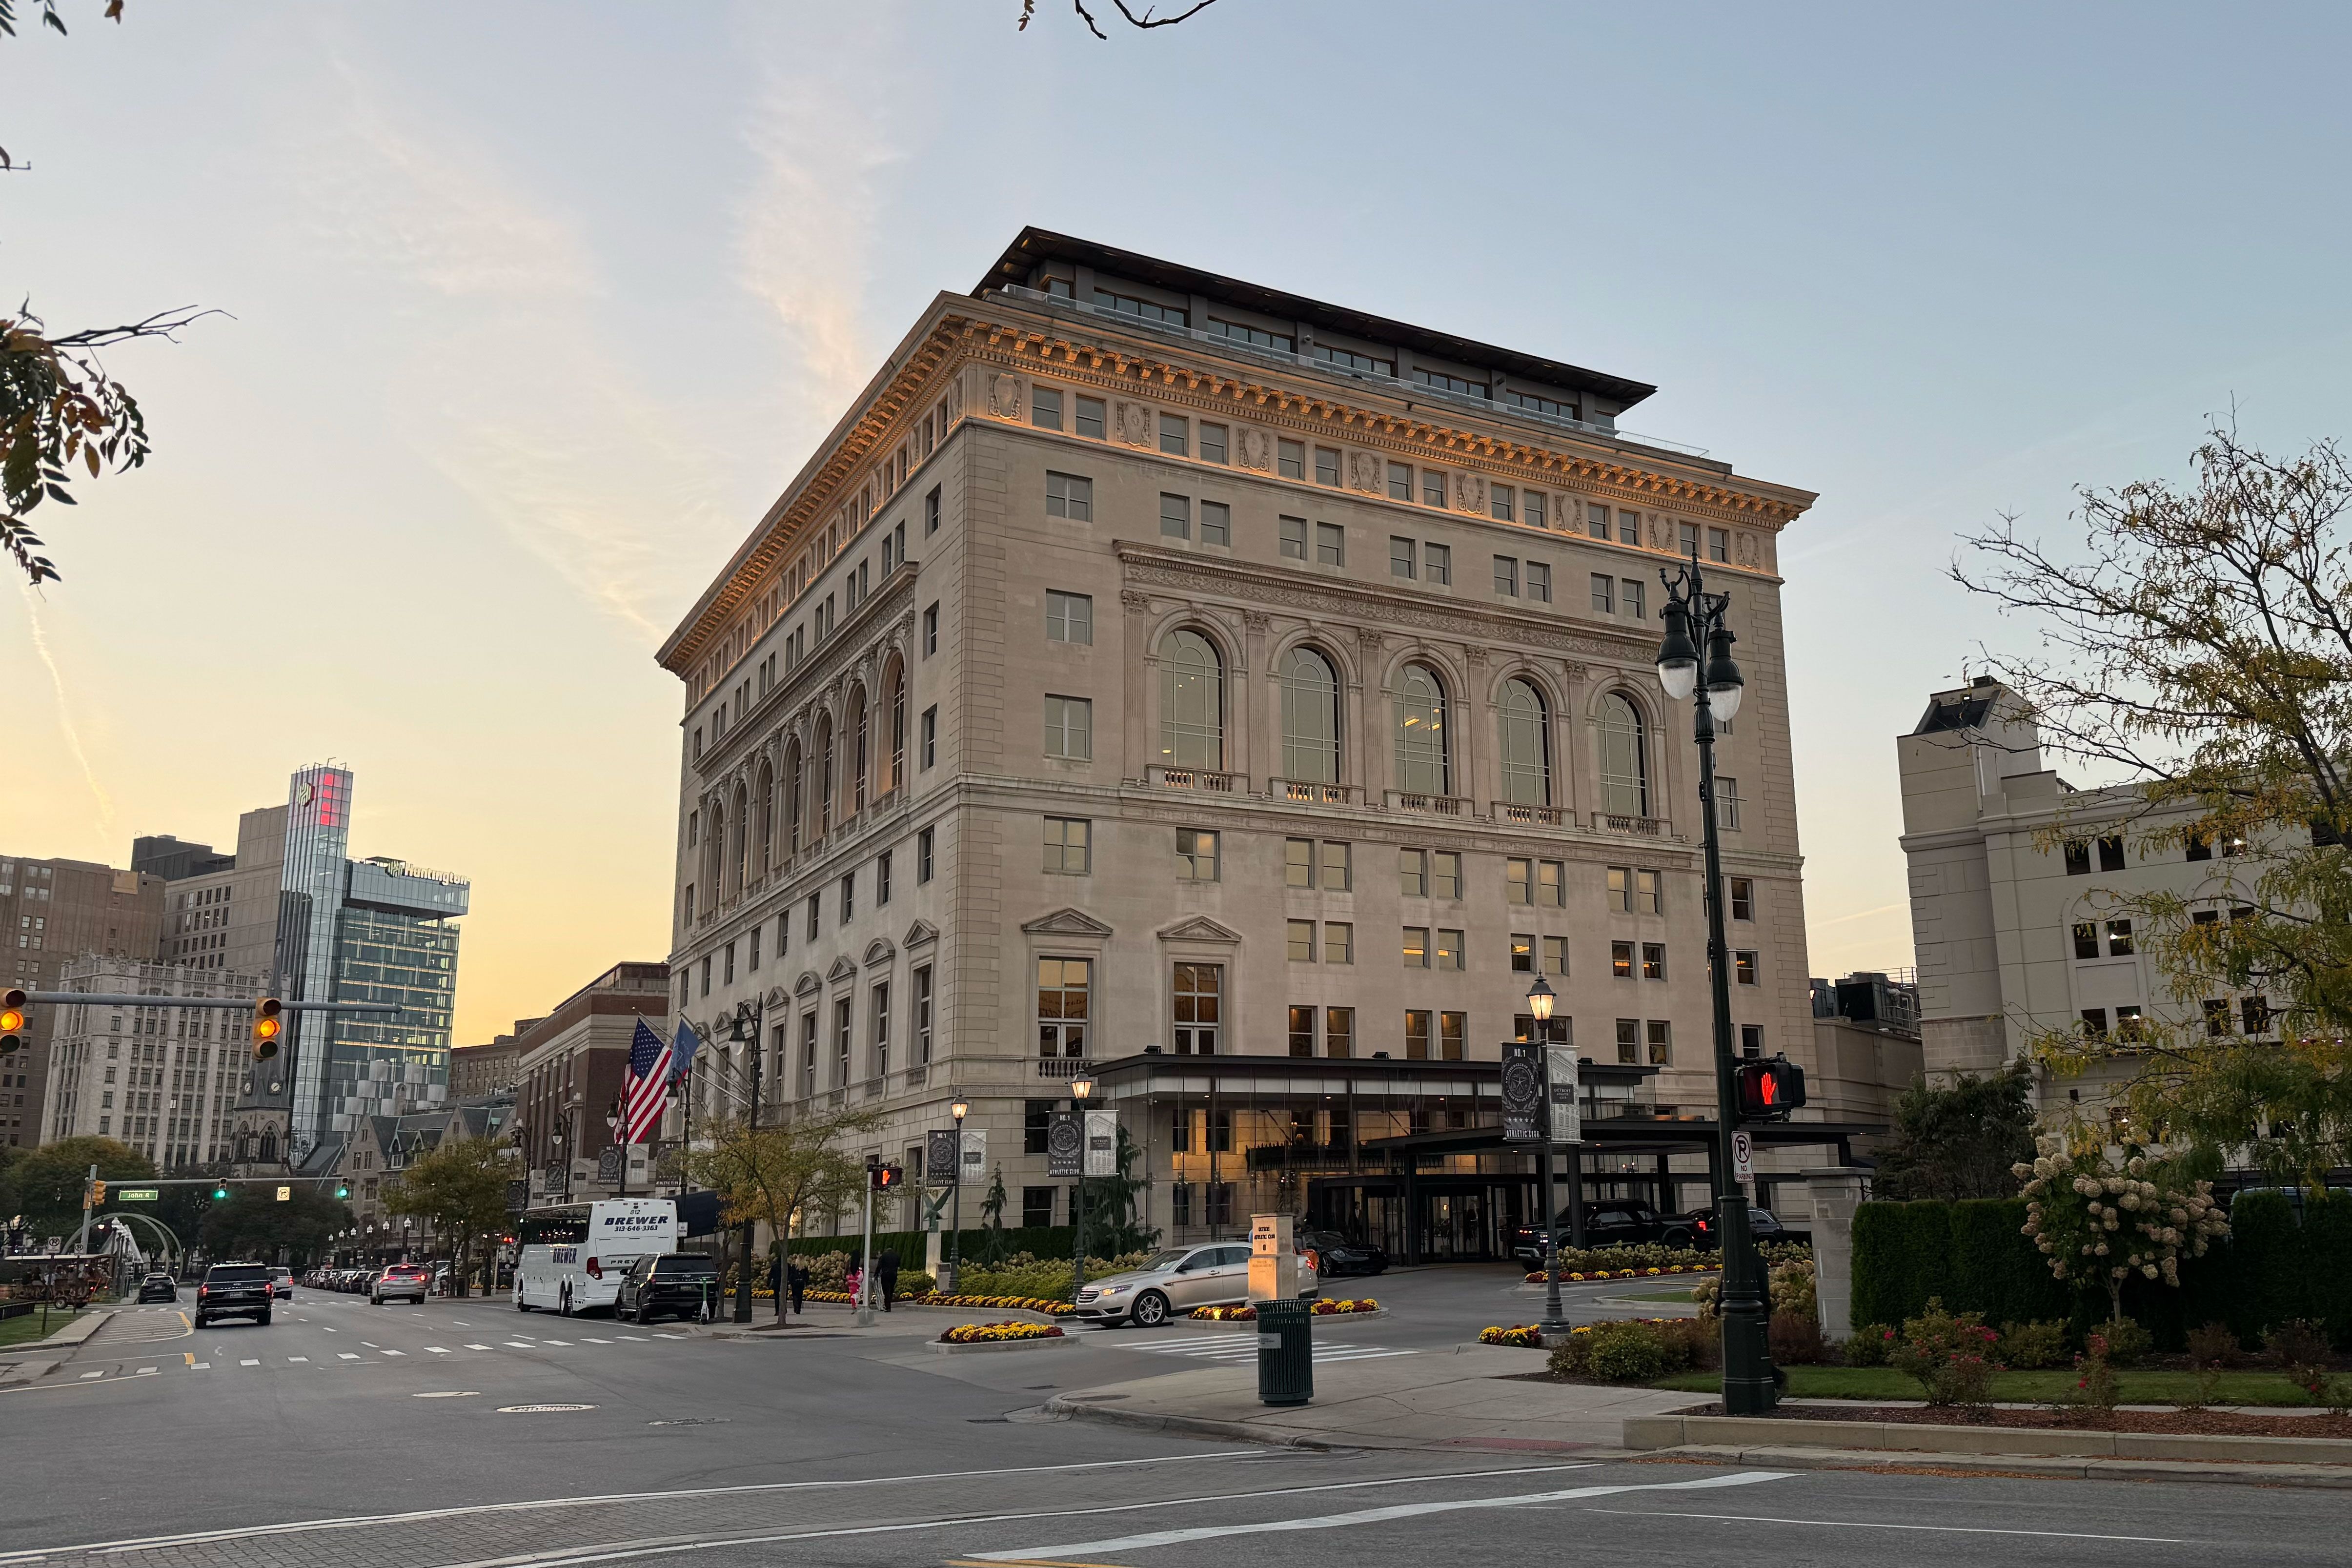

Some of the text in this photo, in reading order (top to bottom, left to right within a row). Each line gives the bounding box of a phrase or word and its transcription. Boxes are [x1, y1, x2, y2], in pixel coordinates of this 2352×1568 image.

[405, 863, 467, 886] Huntington
[1506, 1129, 1527, 1138] ATHLETIC
[605, 1216, 668, 1225] BREWER
[553, 1248, 577, 1263] BREWER
